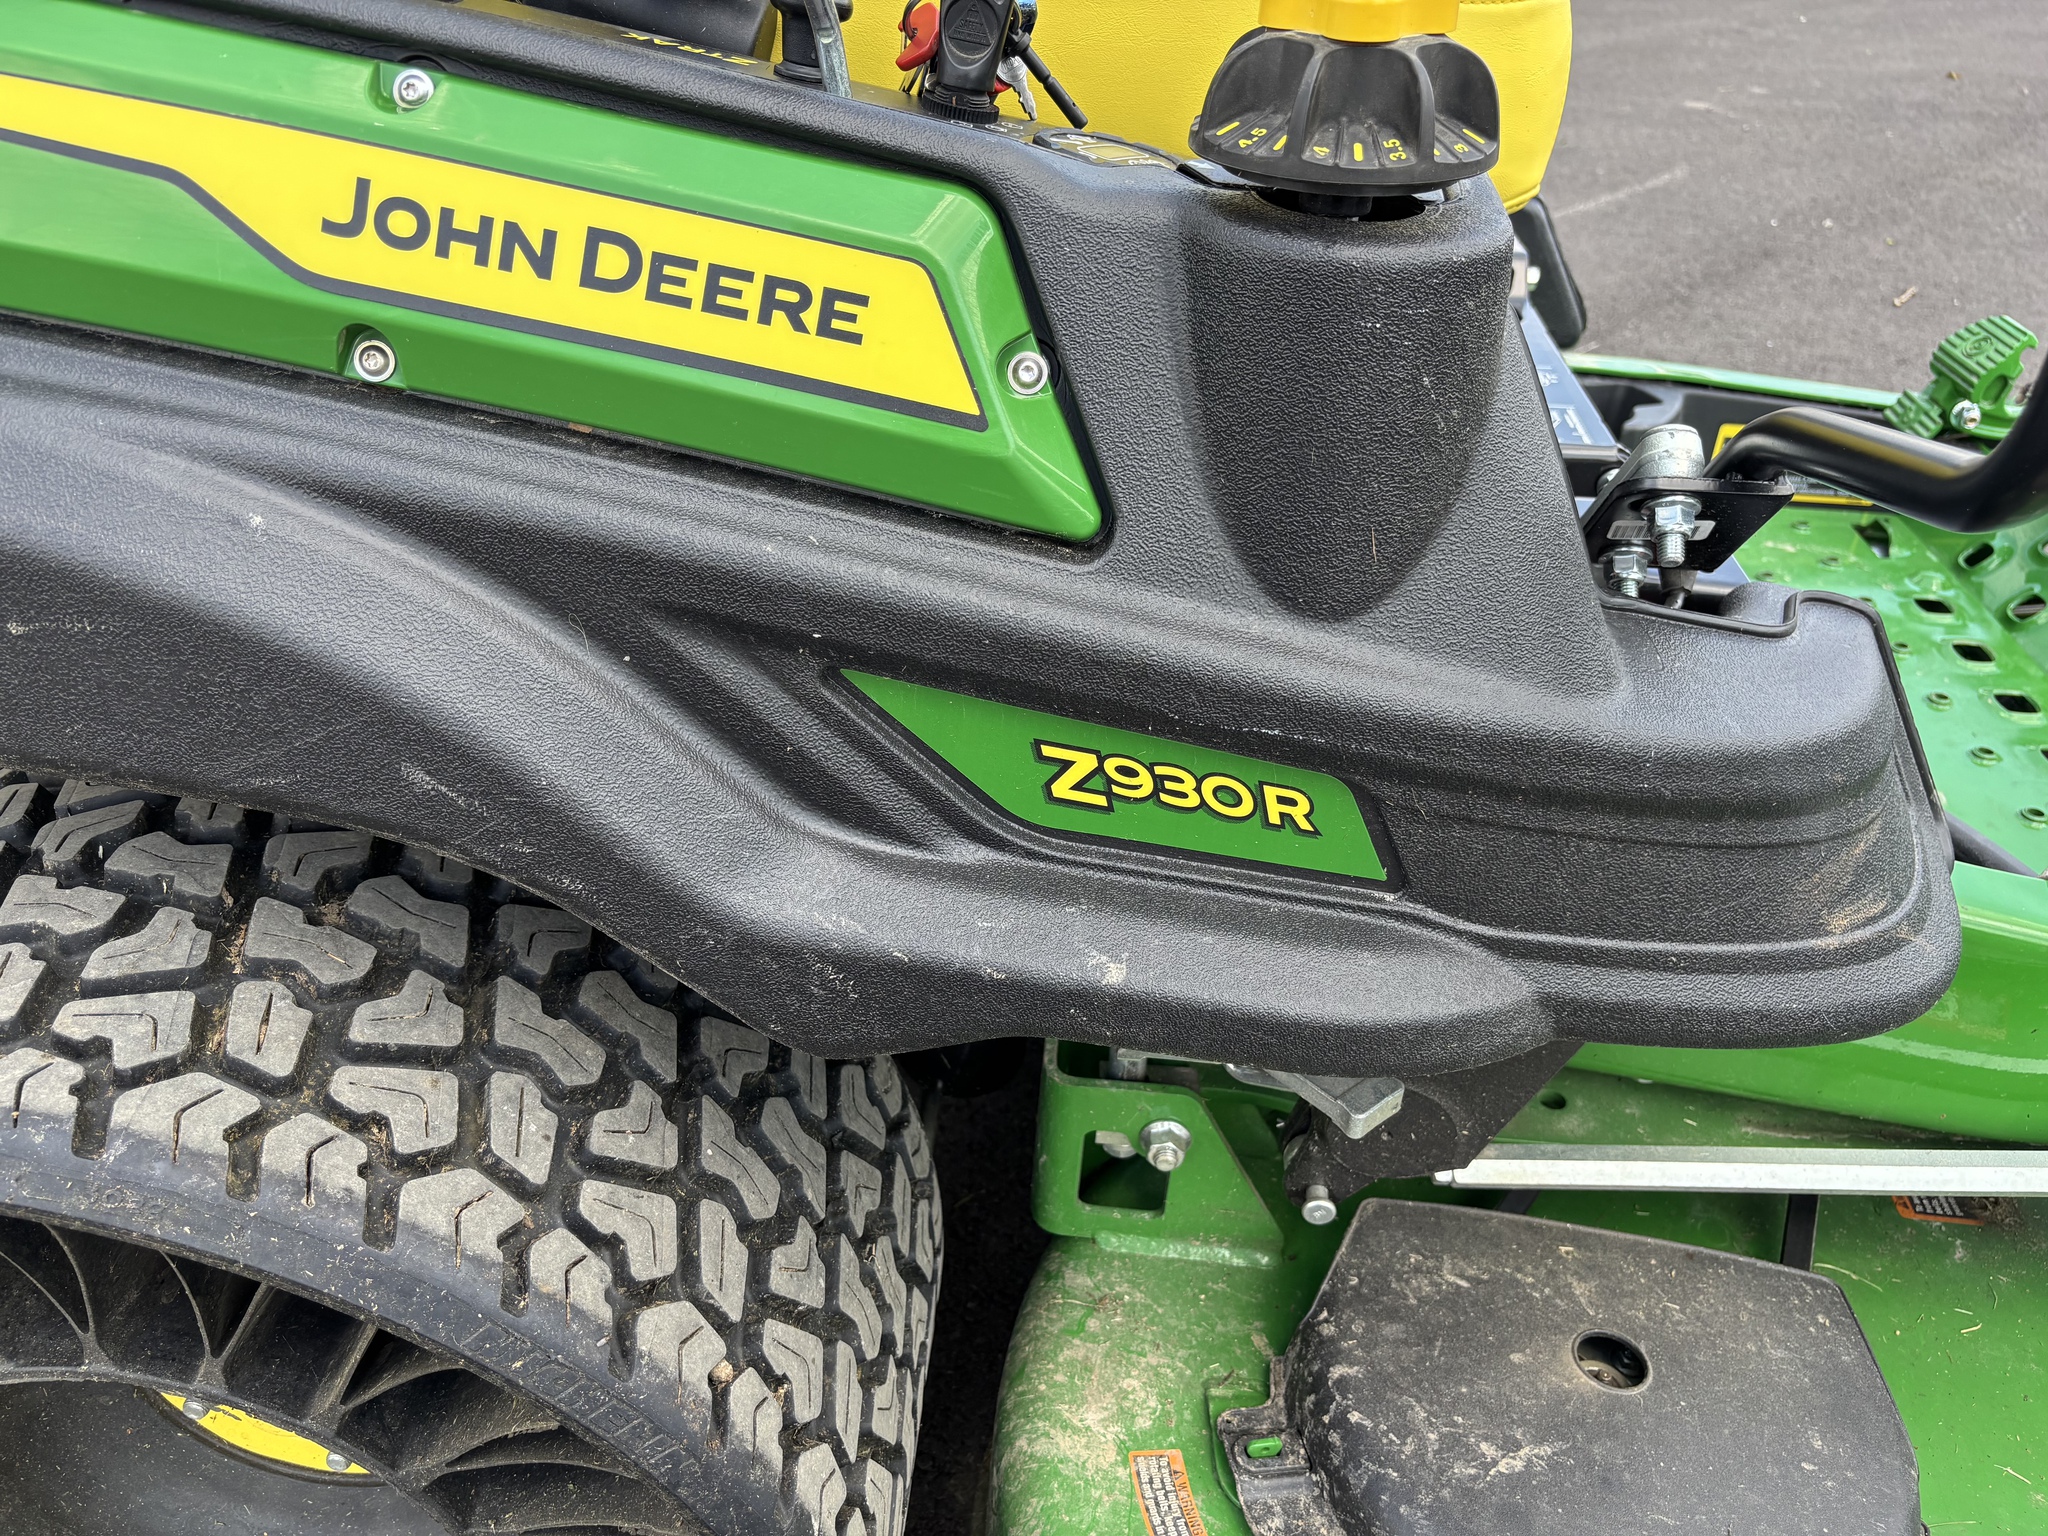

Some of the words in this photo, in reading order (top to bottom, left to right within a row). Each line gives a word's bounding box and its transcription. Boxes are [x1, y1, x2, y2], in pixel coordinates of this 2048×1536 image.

[1312, 145, 1331, 157] 4
[1382, 138, 1407, 161] 3.5
[1453, 142, 1470, 154] 3
[321, 177, 558, 281] JOHN
[579, 226, 870, 346] DEERE
[1033, 739, 1322, 837] Z930R
[1149, 1456, 1162, 1489] rotating
[1159, 1456, 1169, 1467] To
[1142, 1483, 1155, 1498] and
[1161, 1468, 1176, 1491] avoid
[1146, 1499, 1161, 1526] guards
[1167, 1492, 1182, 1517] injury
[1177, 1482, 1204, 1536] WARNING
